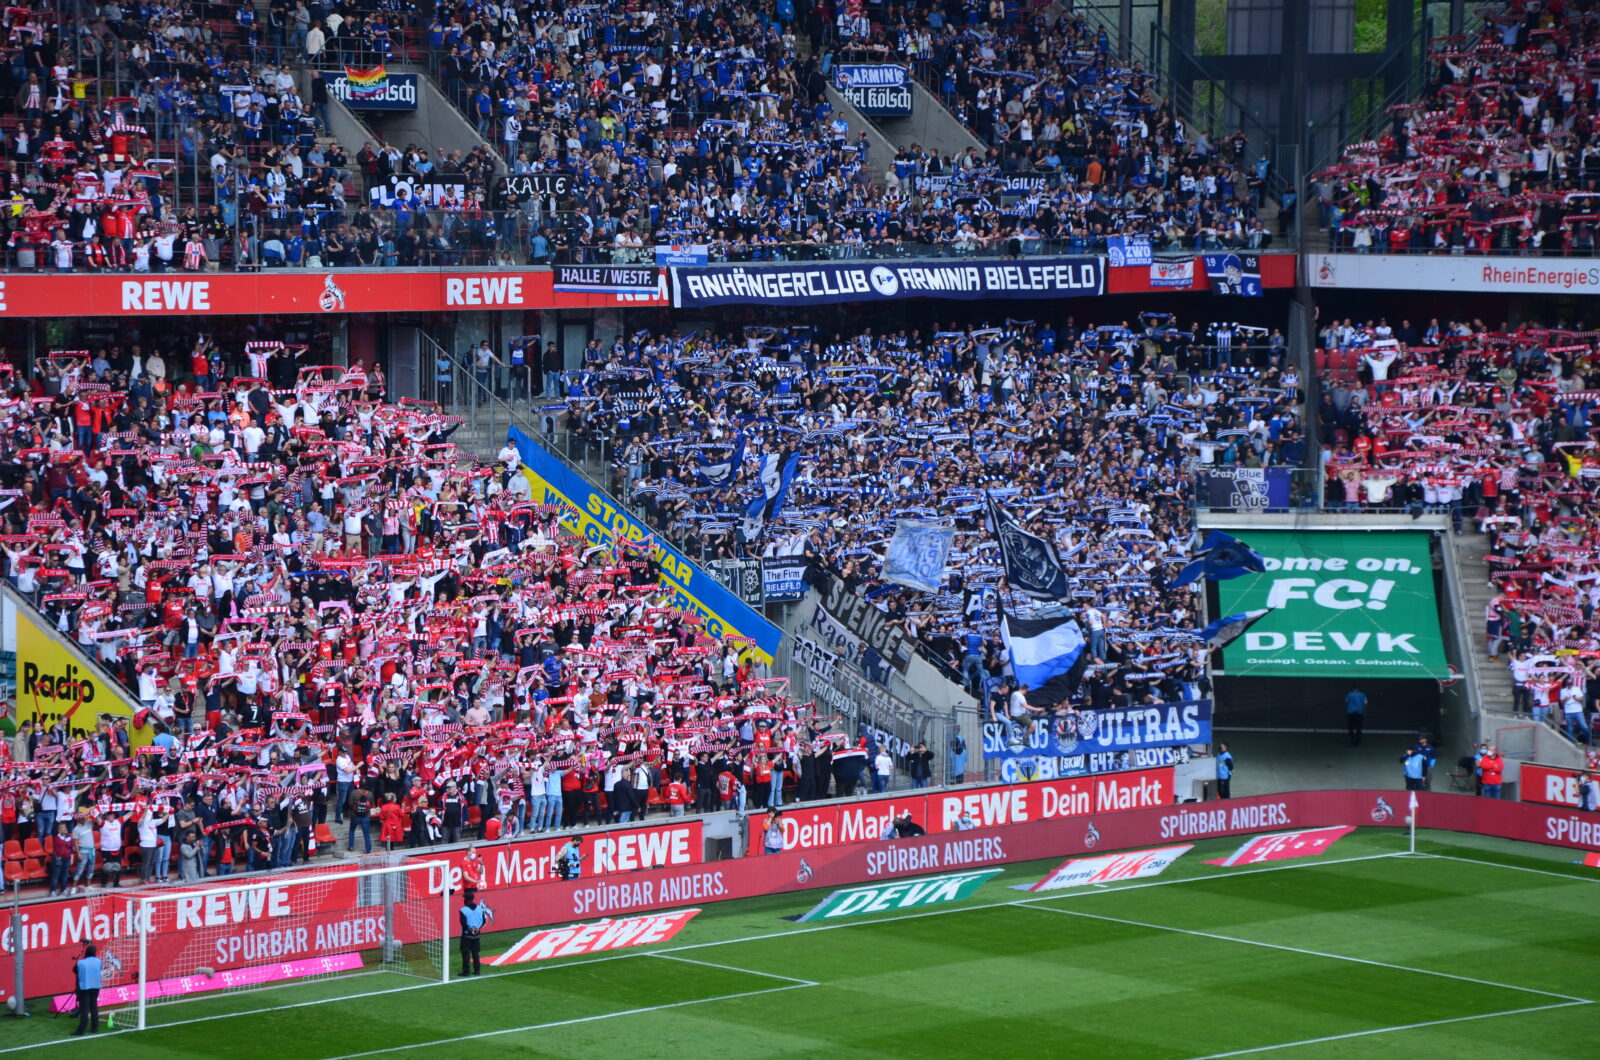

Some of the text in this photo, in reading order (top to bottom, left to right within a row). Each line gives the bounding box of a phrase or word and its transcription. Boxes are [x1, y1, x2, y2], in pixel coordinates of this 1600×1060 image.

[1125, 246, 1151, 258] ZWO
[1206, 258, 1216, 267] 19
[1246, 258, 1257, 267] 05
[446, 277, 523, 305] REWE
[561, 268, 600, 283] HALLE
[611, 269, 652, 285] WESTF.
[687, 268, 871, 298] ANHÄNGERCLUB
[899, 267, 981, 291] ARMINIA
[986, 264, 1095, 291] BIELEFELD
[121, 281, 210, 310] REWE
[1210, 469, 1262, 479] Crazy Blue
[586, 492, 643, 541] STOP
[766, 569, 800, 580] The Firm
[1264, 557, 1422, 574] ome on,
[766, 582, 801, 592] BIELEFELD
[1266, 578, 1396, 610] FC!
[827, 581, 904, 660] SPENGE
[1245, 632, 1421, 653] DEVK
[1355, 658, 1424, 667] Geholfen.
[24, 662, 95, 703] Radio
[1097, 704, 1200, 746] ULTRAS
[1135, 747, 1174, 767] BOYS
[942, 776, 1162, 830] REWE Dein Markt
[1160, 802, 1291, 838] SPÜRBAR ANDERS.
[782, 815, 833, 849] Dein
[594, 829, 690, 873] REWE
[866, 837, 1007, 875] SPÜRBAR ANDERS.
[176, 882, 292, 929] REWE
[573, 872, 728, 914] SPÜRBAR ANDERS.
[824, 877, 972, 918] DEVK
[216, 927, 308, 964] SPÜRBAR
[526, 910, 685, 960] REWE
